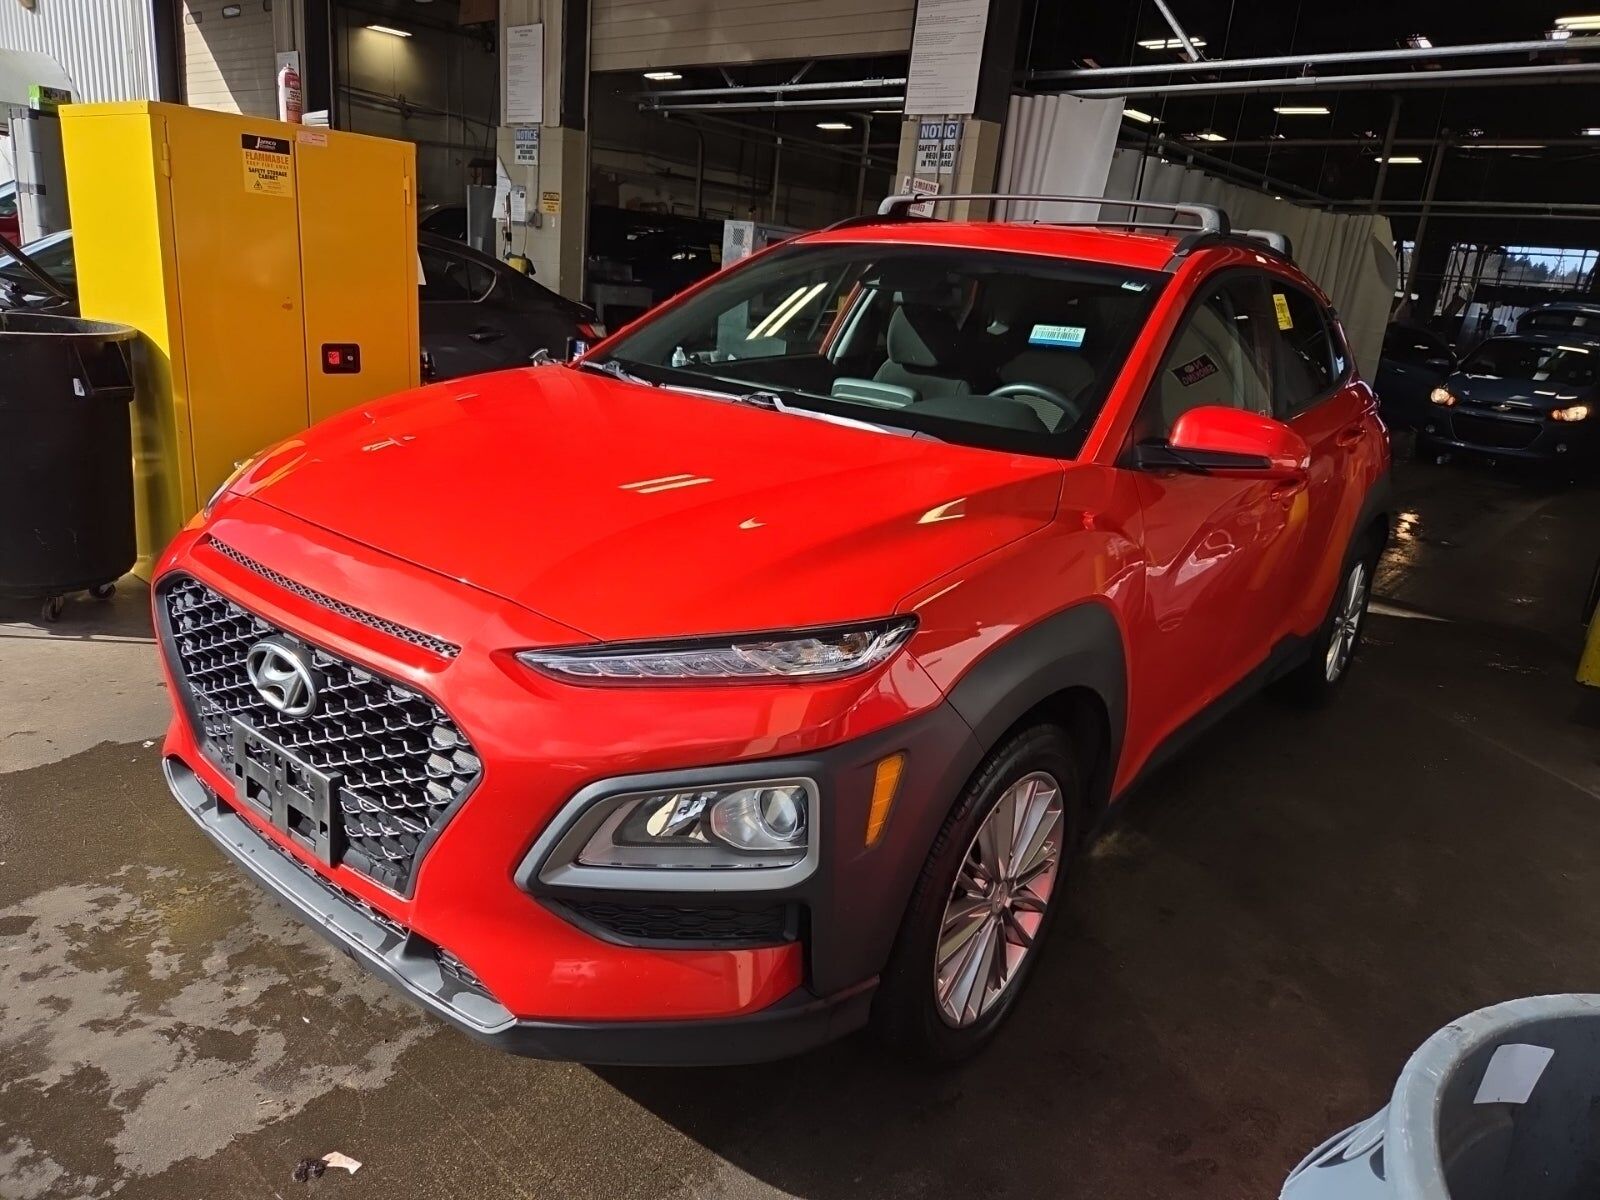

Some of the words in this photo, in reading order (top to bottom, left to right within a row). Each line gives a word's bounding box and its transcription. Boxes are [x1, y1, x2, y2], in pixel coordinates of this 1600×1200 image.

[516, 130, 537, 140] NOTICE
[918, 144, 937, 152] SAFETY
[245, 151, 289, 165] FLAMMABLE
[258, 173, 279, 181] CABINET
[267, 169, 288, 177] STORAGE
[914, 181, 937, 194] SMOKING
